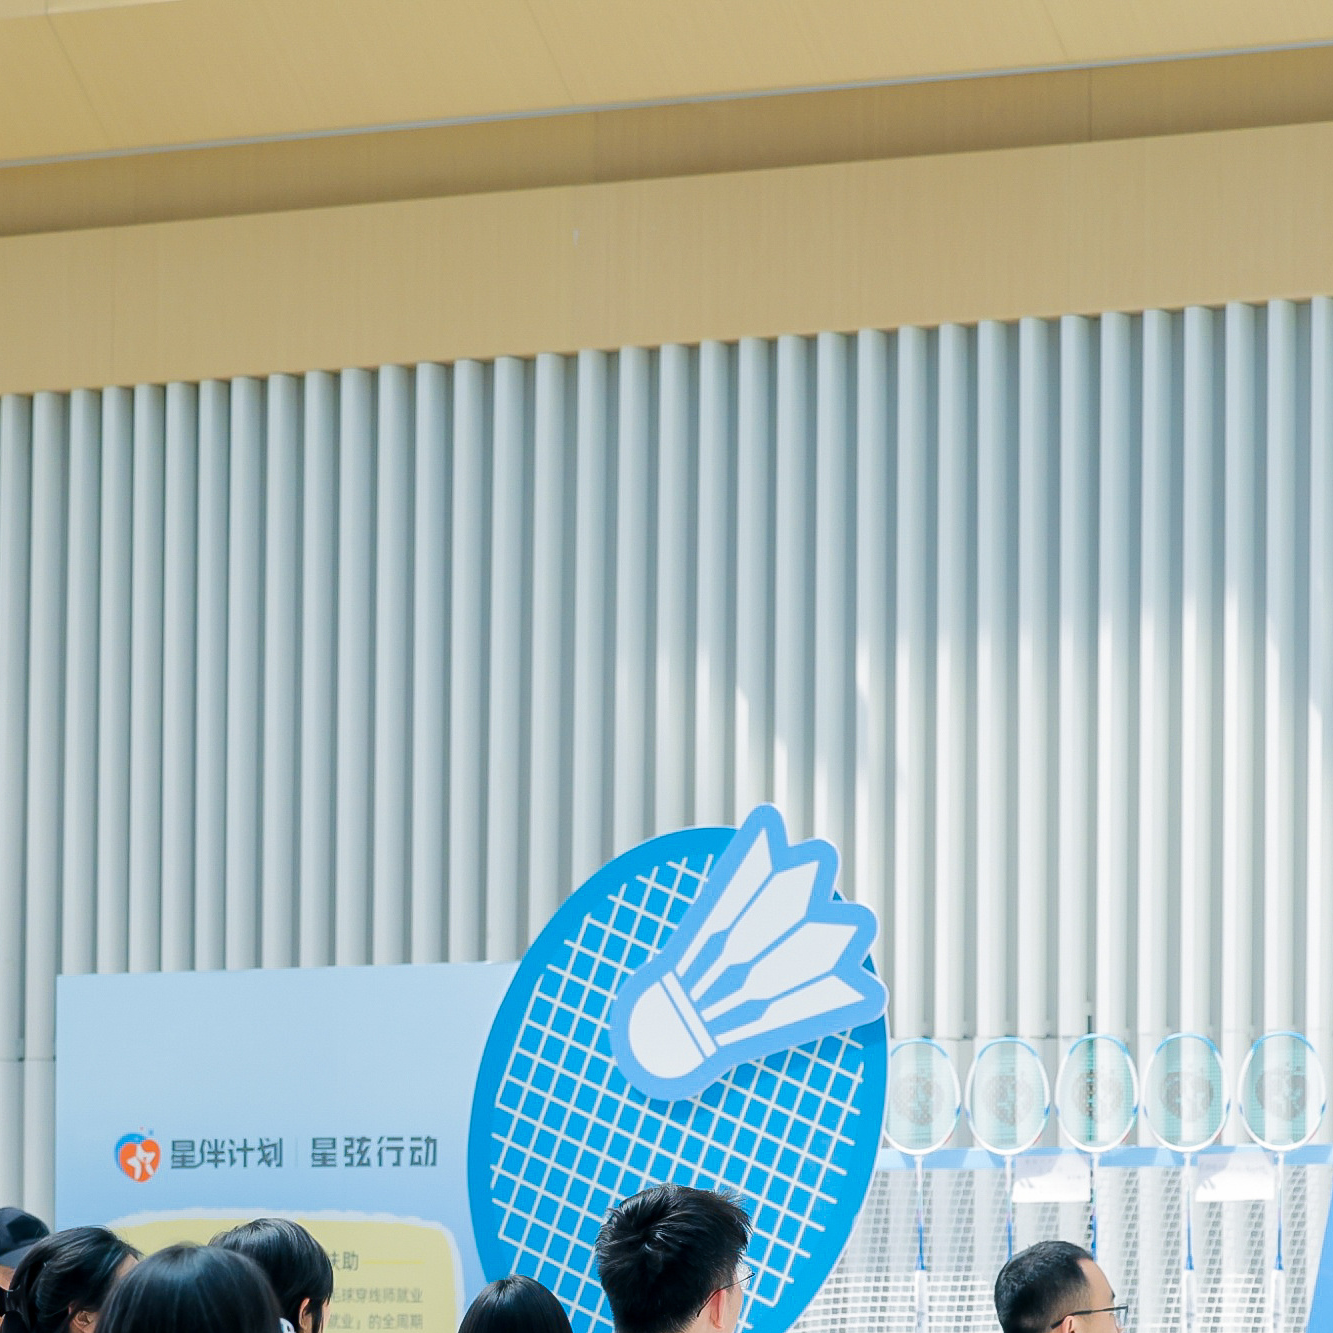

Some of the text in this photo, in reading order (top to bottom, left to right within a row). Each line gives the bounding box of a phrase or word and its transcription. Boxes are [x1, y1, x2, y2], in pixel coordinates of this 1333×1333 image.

[170, 1135, 438, 1169] 星伴计划 星弦行动
